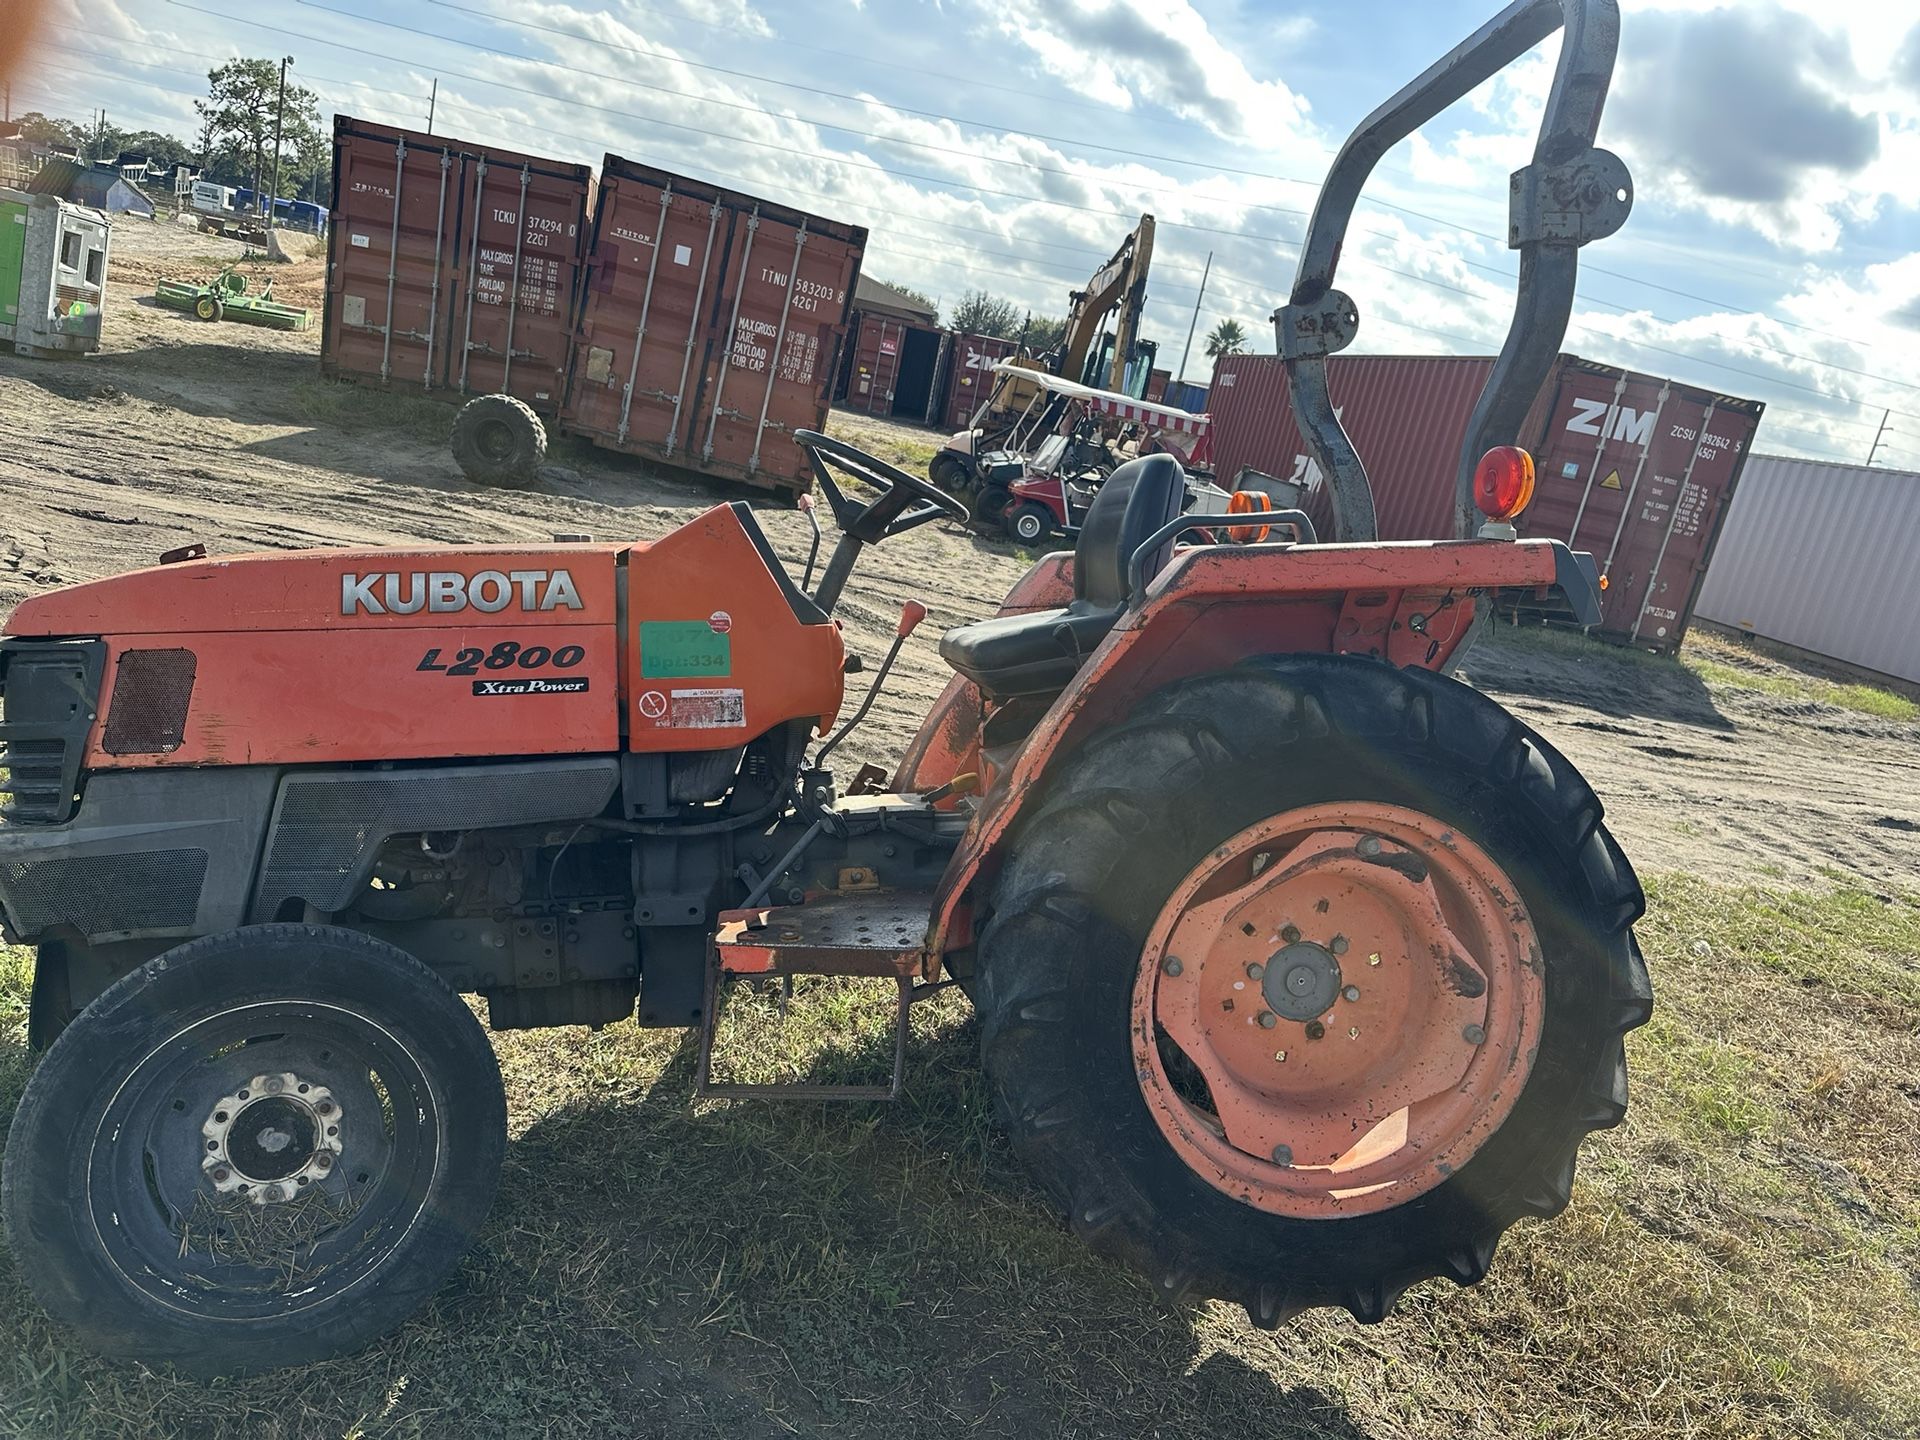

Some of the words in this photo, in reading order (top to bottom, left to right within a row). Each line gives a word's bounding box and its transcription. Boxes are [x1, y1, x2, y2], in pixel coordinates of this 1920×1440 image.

[493, 209, 516, 224] TCKU
[528, 216, 562, 234] 374294
[569, 224, 576, 237] 0
[526, 232, 549, 247] 22G1
[616, 227, 651, 242] TRITON
[479, 263, 495, 276] TARE
[478, 277, 506, 293] PAYLOAD
[761, 268, 788, 287] TTNU
[795, 278, 834, 300] 583203
[837, 291, 844, 304] 8
[792, 295, 818, 312] 42G1
[736, 329, 756, 345] TARE
[733, 341, 767, 360] PAYLOAD
[965, 353, 1002, 373] ZIM
[1566, 397, 1657, 447] ZIM
[1670, 425, 1697, 441] ZCSU
[340, 569, 585, 616] KUBOTA
[415, 641, 586, 677] L2800
